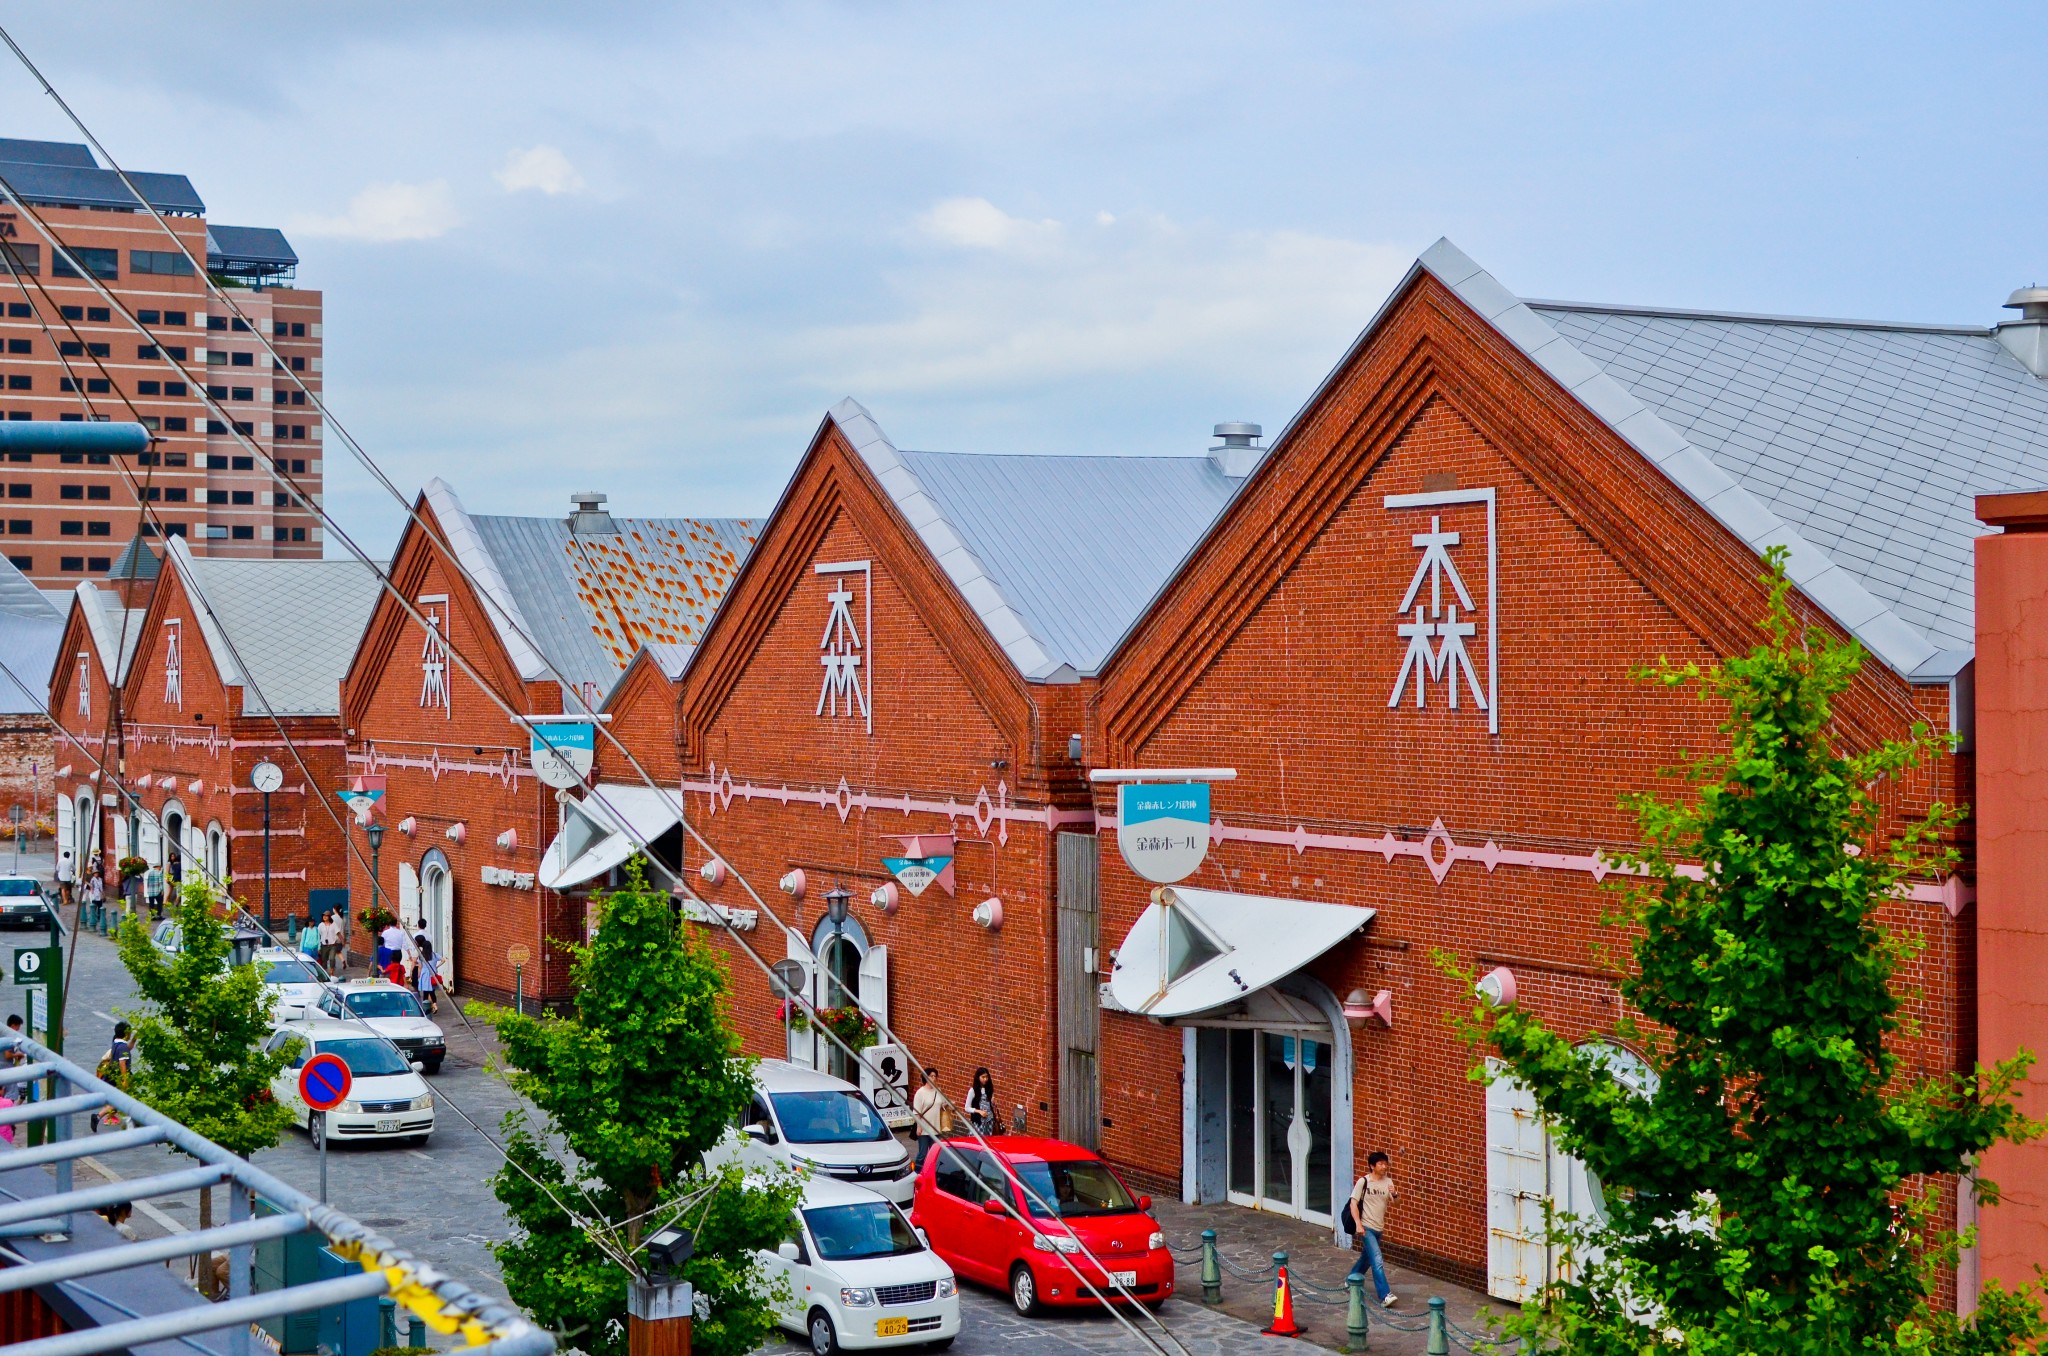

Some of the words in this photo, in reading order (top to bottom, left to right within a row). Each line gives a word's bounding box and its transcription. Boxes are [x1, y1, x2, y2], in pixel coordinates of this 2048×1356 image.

[1136, 836, 1197, 852] 金森ホール
[884, 1323, 907, 1335] 40-29
